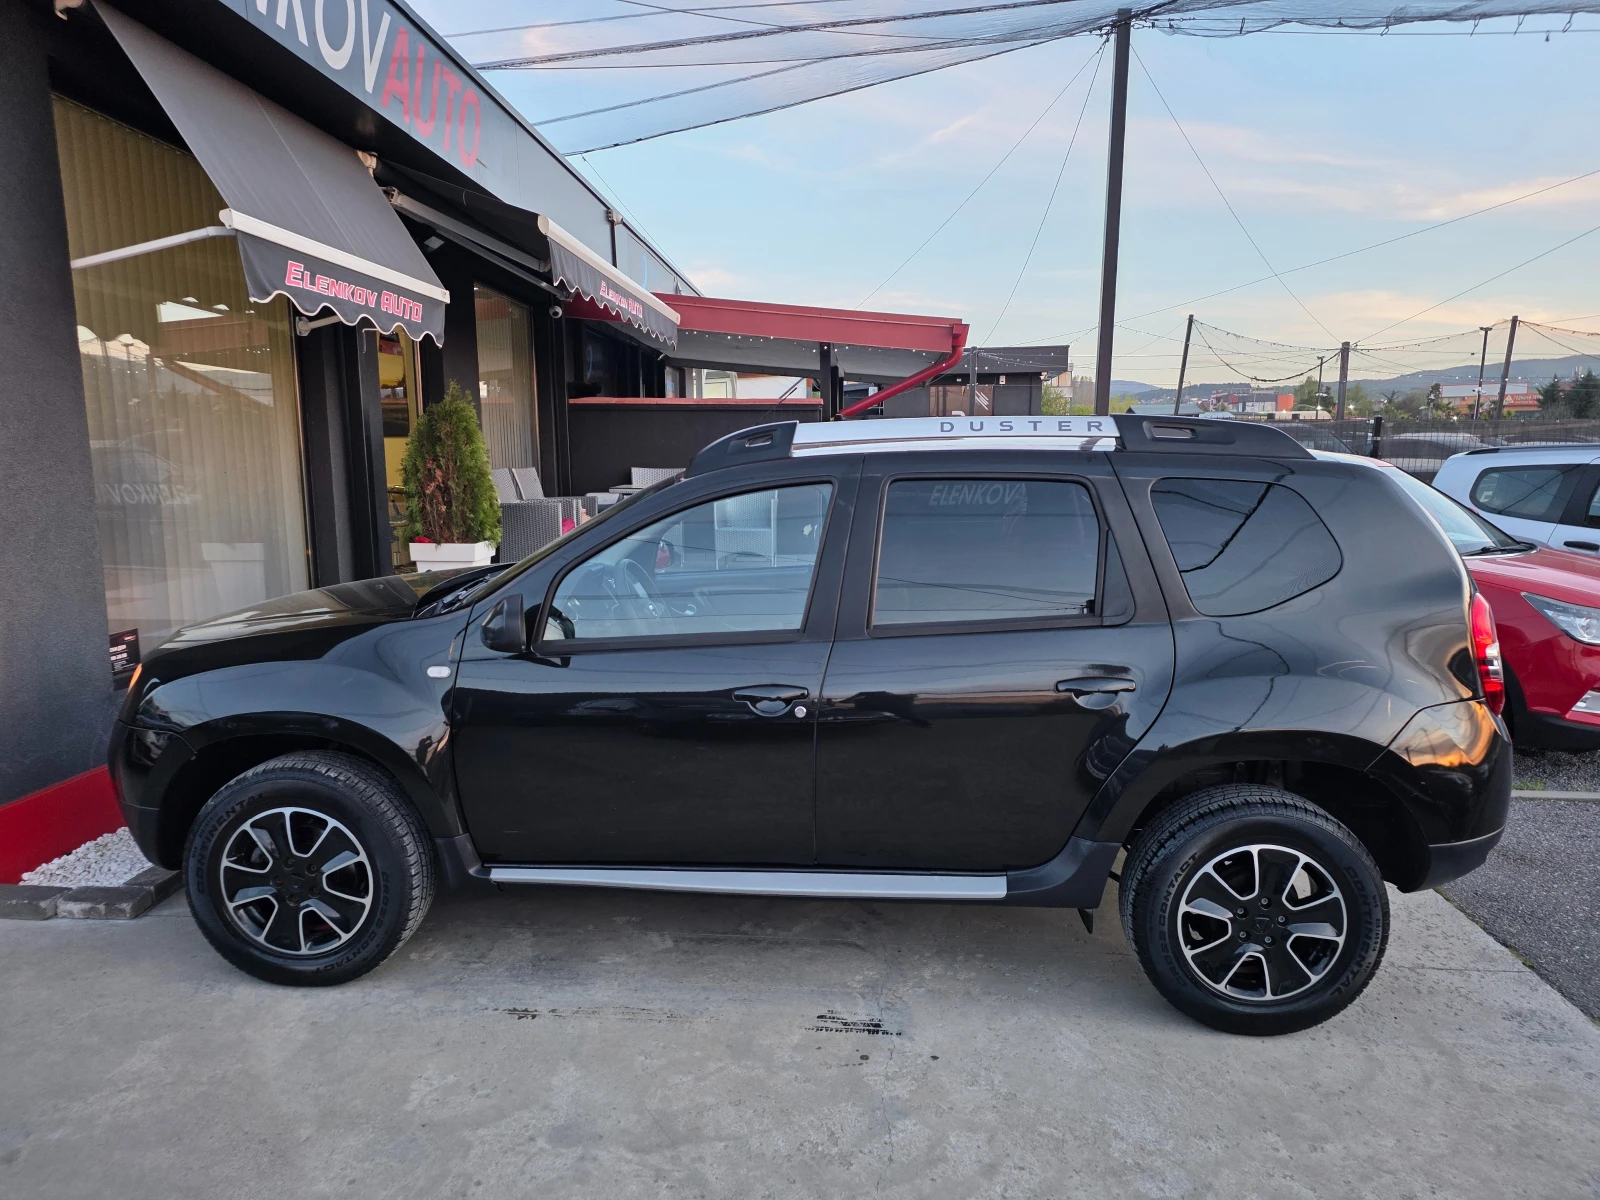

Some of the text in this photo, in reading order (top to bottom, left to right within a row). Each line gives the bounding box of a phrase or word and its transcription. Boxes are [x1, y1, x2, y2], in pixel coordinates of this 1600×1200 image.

[381, 26, 481, 169] AUTO
[285, 260, 423, 323] ELENKOV AUTO
[940, 420, 1104, 433] DUSTER
